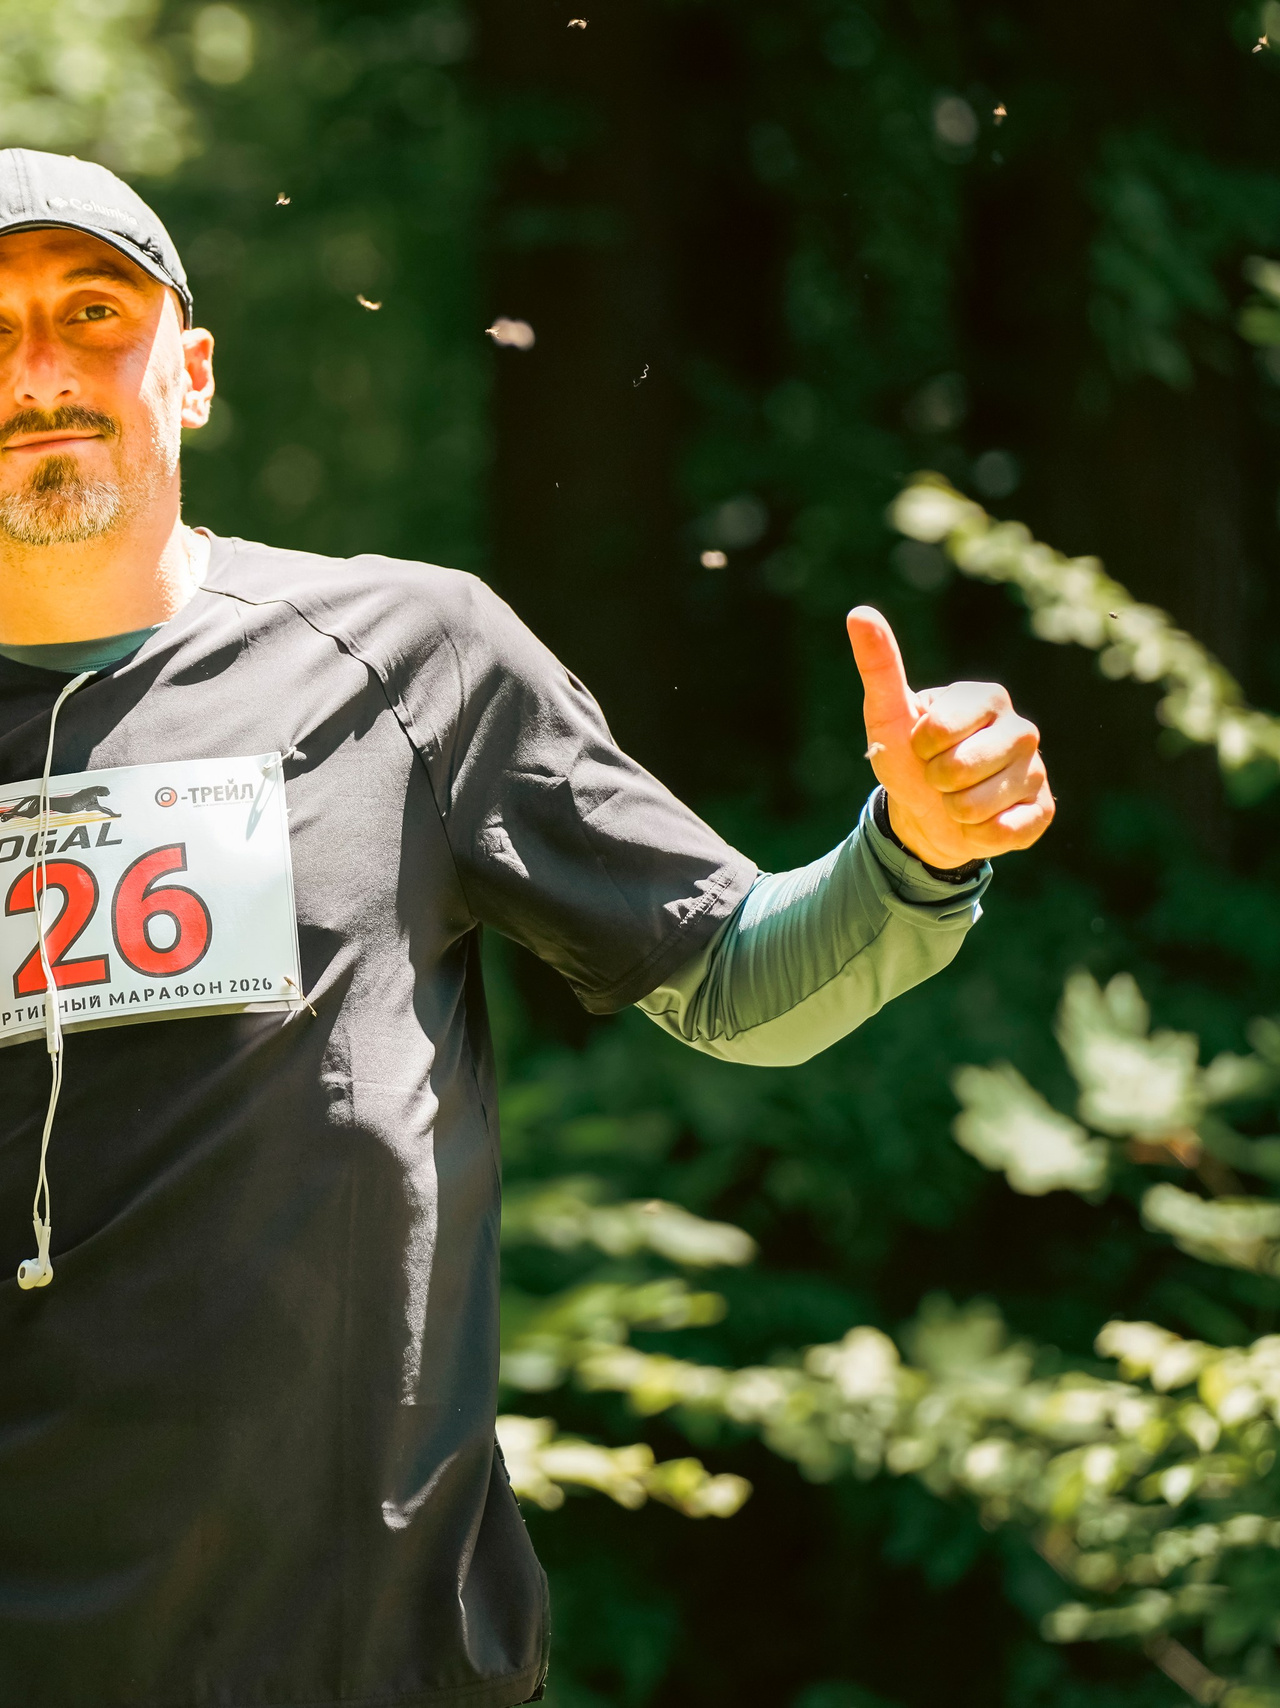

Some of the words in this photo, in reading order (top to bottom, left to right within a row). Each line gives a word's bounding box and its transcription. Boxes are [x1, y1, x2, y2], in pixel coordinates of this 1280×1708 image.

[5, 842, 212, 999] 26
[109, 981, 222, 1006] МАРАФОН
[229, 978, 272, 993] 2026
